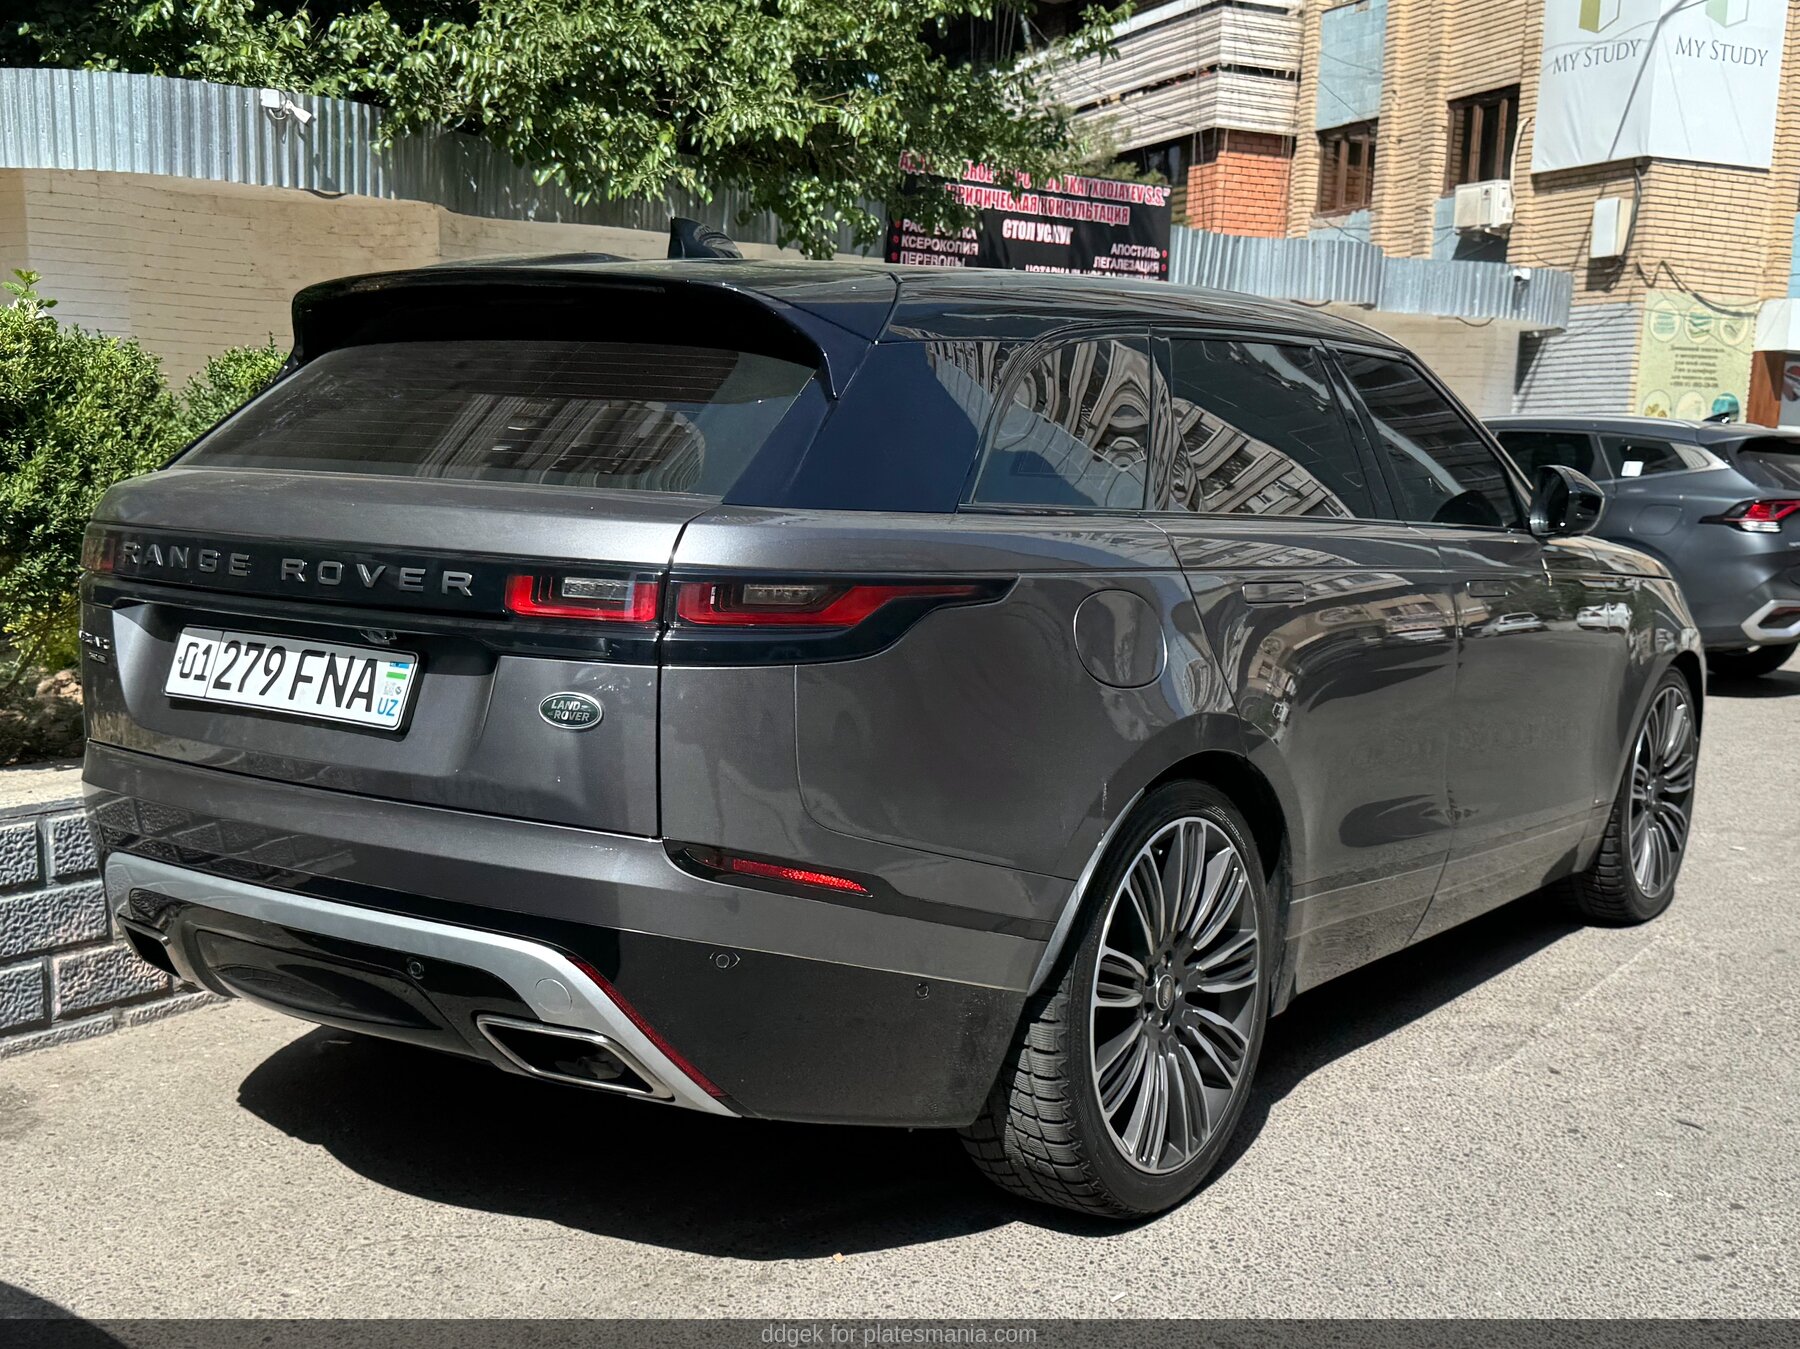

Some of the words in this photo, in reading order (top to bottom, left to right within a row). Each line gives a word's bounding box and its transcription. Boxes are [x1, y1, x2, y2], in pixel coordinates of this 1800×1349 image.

[1552, 52, 1579, 75] MY
[1583, 38, 1642, 68] STUDY
[1675, 35, 1706, 58] MY
[1709, 40, 1768, 67] STUDY
[1002, 218, 1035, 241] СТОЛ
[901, 235, 979, 256] КСЕРОКОПИЯ
[1110, 243, 1160, 259] АПОСТИЛЬ
[121, 541, 251, 577] RANGE
[281, 558, 473, 597] ROVER
[178, 642, 213, 681] 01
[212, 640, 287, 696] 279
[288, 649, 378, 712] FNA
[377, 699, 399, 717] UZ
[551, 700, 581, 711] LAND
[553, 710, 590, 721] ROVER
